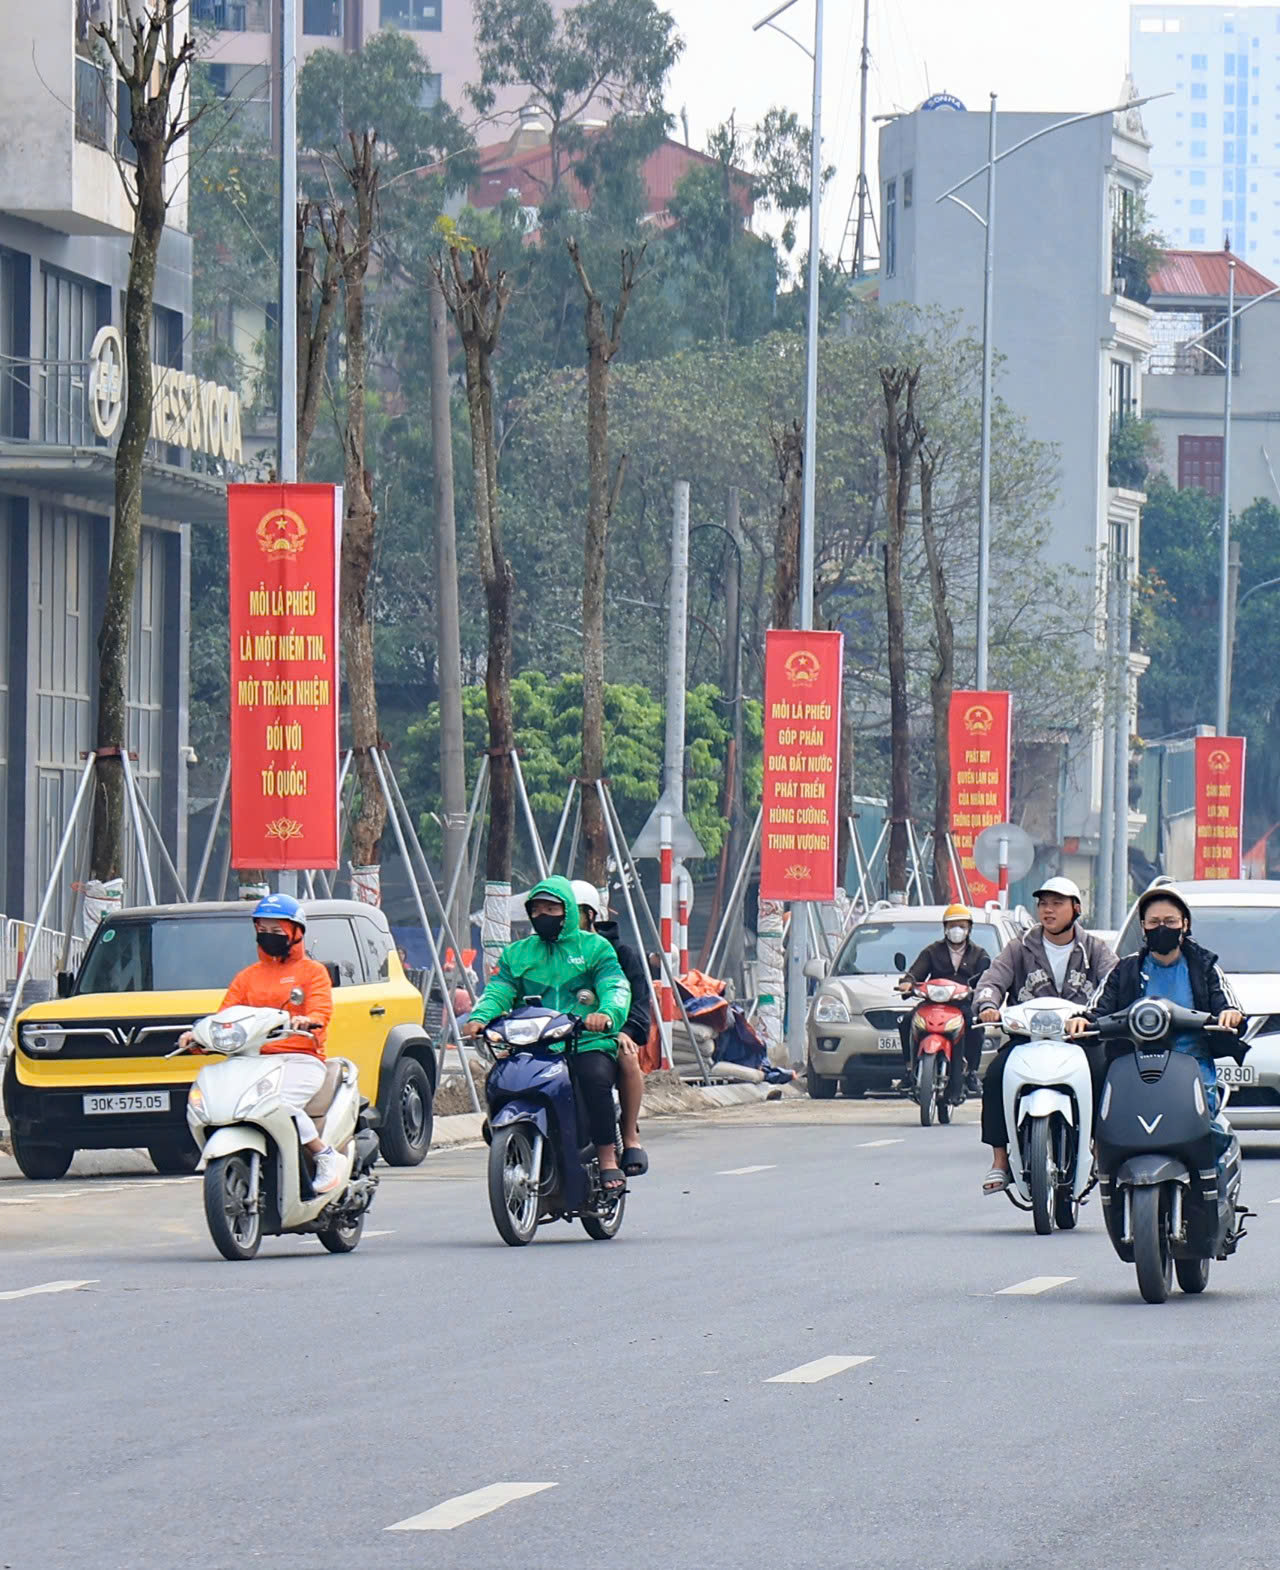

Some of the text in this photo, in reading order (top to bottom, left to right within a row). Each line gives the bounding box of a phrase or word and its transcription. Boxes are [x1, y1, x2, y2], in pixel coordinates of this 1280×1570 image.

[249, 581, 316, 616] MỖI LÁ PHIẾU
[240, 629, 253, 661] LÀ
[255, 629, 277, 667] MỘT
[306, 635, 328, 664] TIN,
[238, 674, 330, 712] MỘT TRÁCH NHIỆM
[772, 698, 831, 720] MỖI LÁ PHIẾU
[266, 716, 302, 751] ĐỐI VỚI
[779, 725, 824, 746] GÓP PHẦN
[768, 752, 833, 772] ĐƯA ĐẤT NƯỚC
[262, 760, 308, 799] TỔ QUỐC!
[775, 777, 825, 799] PHÁT TRIỂN
[769, 805, 829, 827] HÙNG CƯỜNG,
[768, 834, 830, 854] THỊNH VƯỢNG!
[91, 1096, 162, 1111] 30K-575.05
